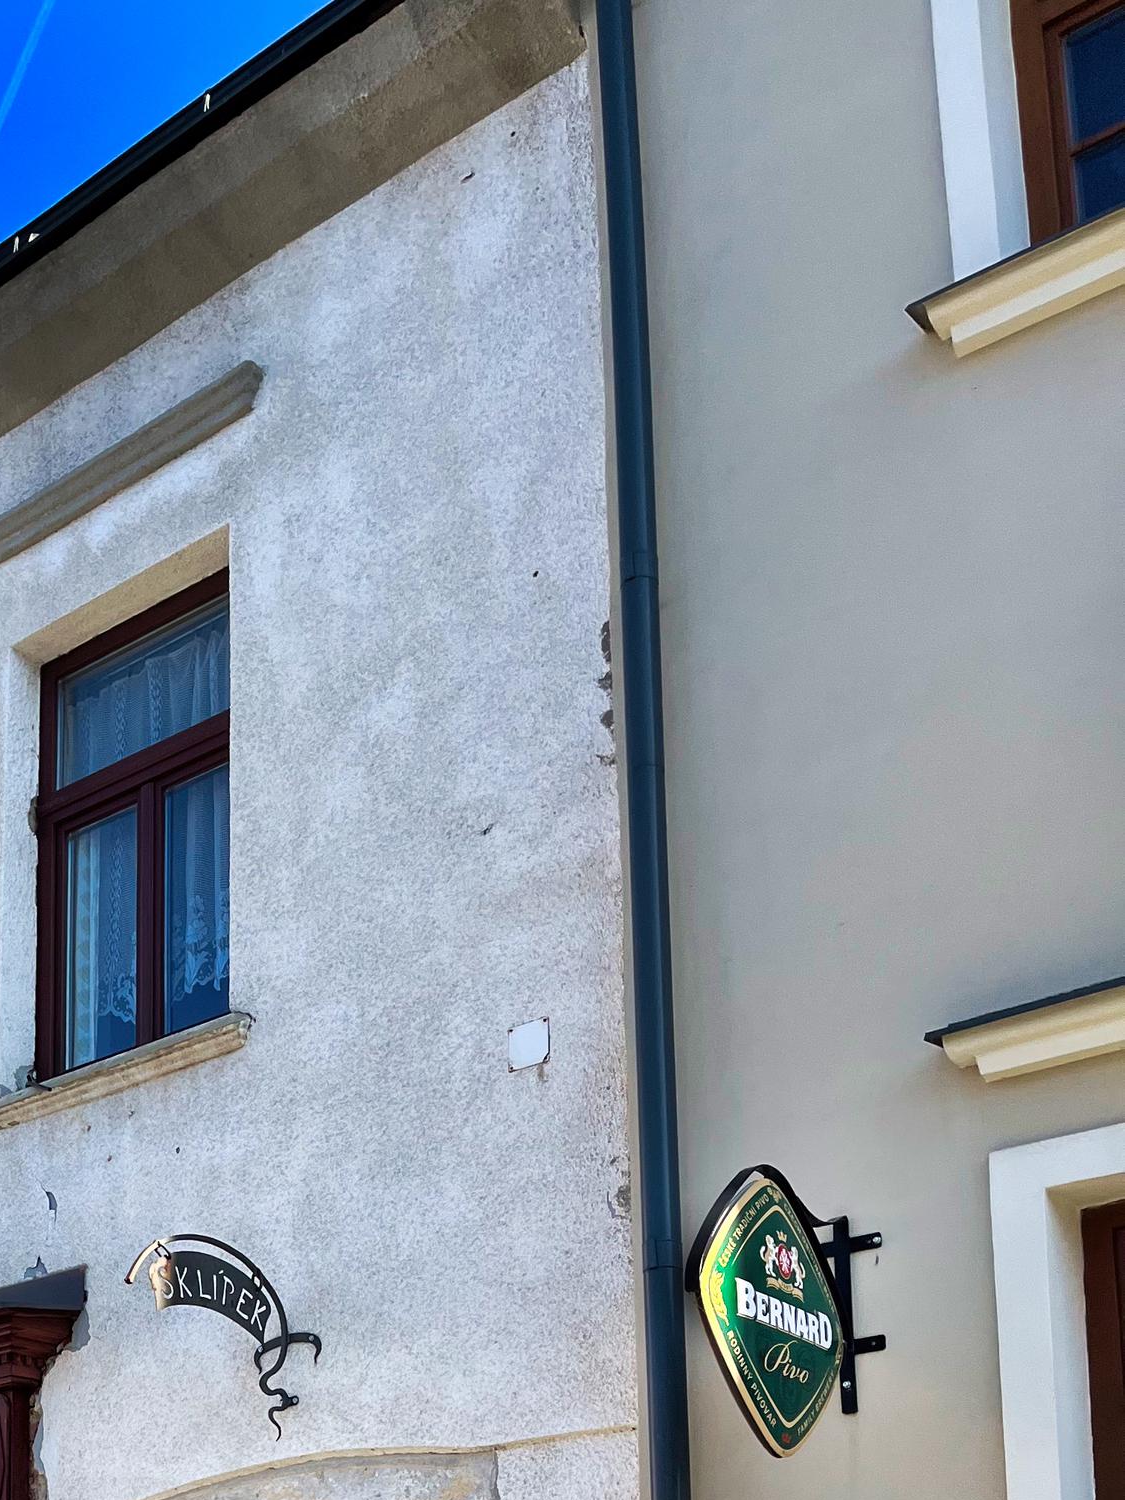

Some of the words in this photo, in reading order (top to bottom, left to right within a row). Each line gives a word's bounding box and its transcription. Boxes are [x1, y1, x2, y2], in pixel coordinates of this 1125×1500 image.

[754, 1193, 770, 1209] PIVO
[158, 1266, 266, 1331] SKLÍPEK
[735, 1277, 832, 1350] BERNARD
[764, 1340, 809, 1383] Pivo
[751, 1382, 777, 1427] PIVOVAR
